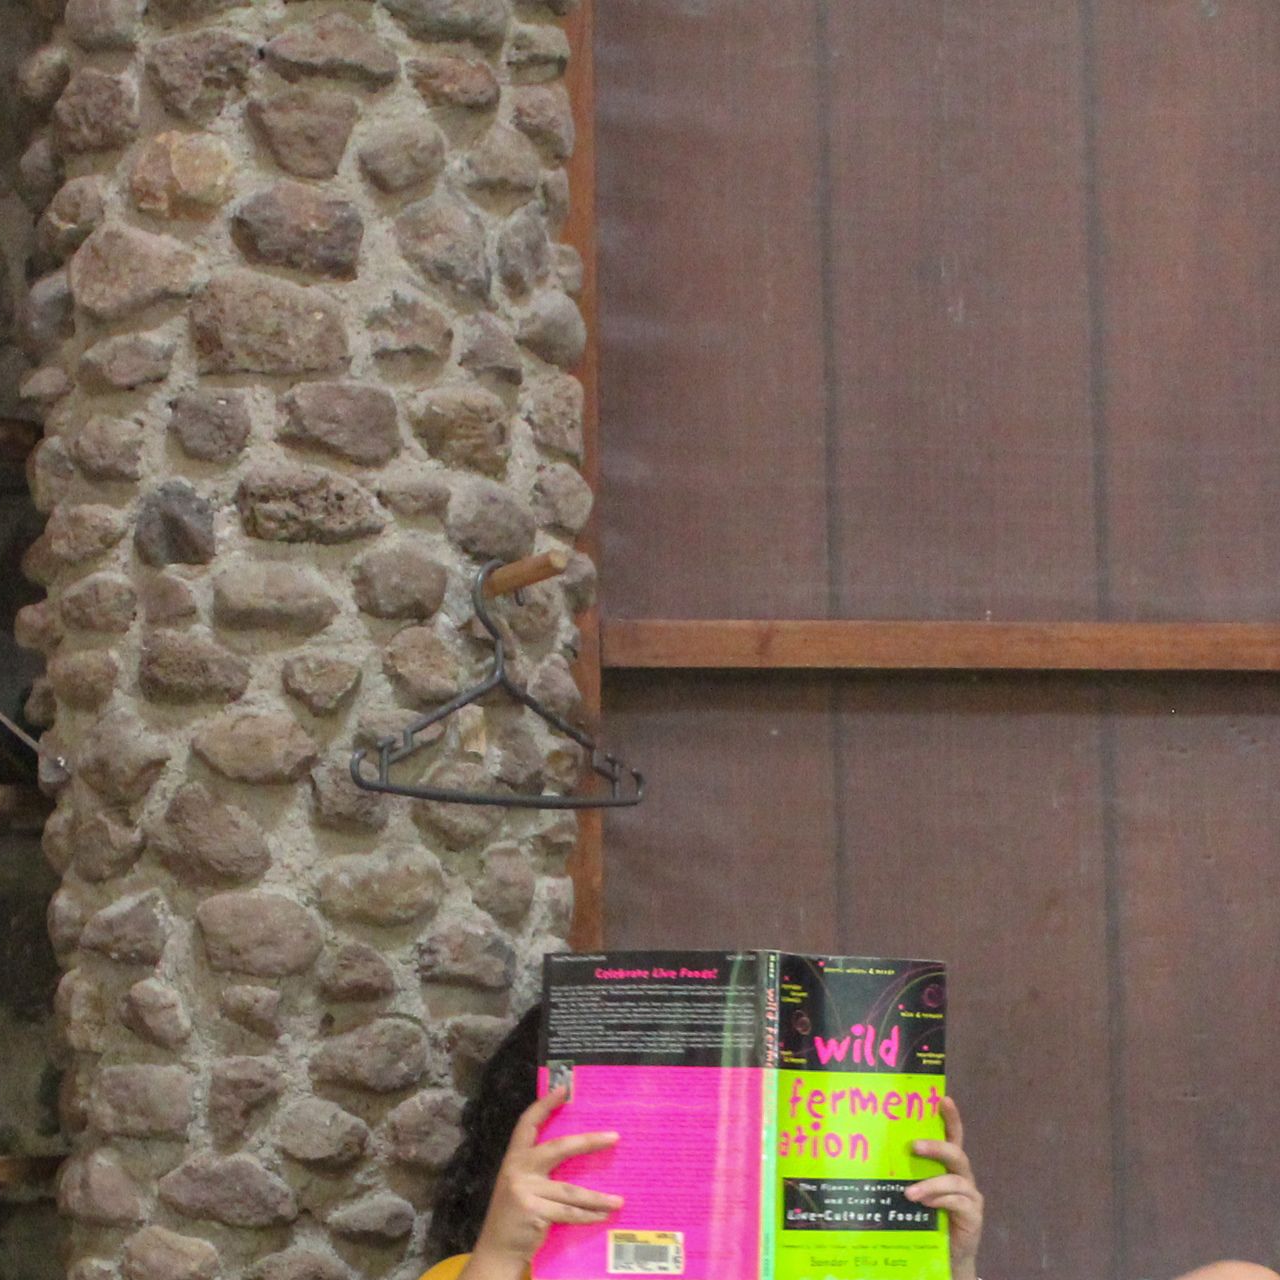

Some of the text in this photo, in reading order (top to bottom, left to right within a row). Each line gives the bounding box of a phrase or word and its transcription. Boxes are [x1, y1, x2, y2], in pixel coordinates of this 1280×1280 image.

[813, 1022, 901, 1068] wild
[789, 1077, 942, 1122] ferment
[777, 1120, 869, 1163] ation
